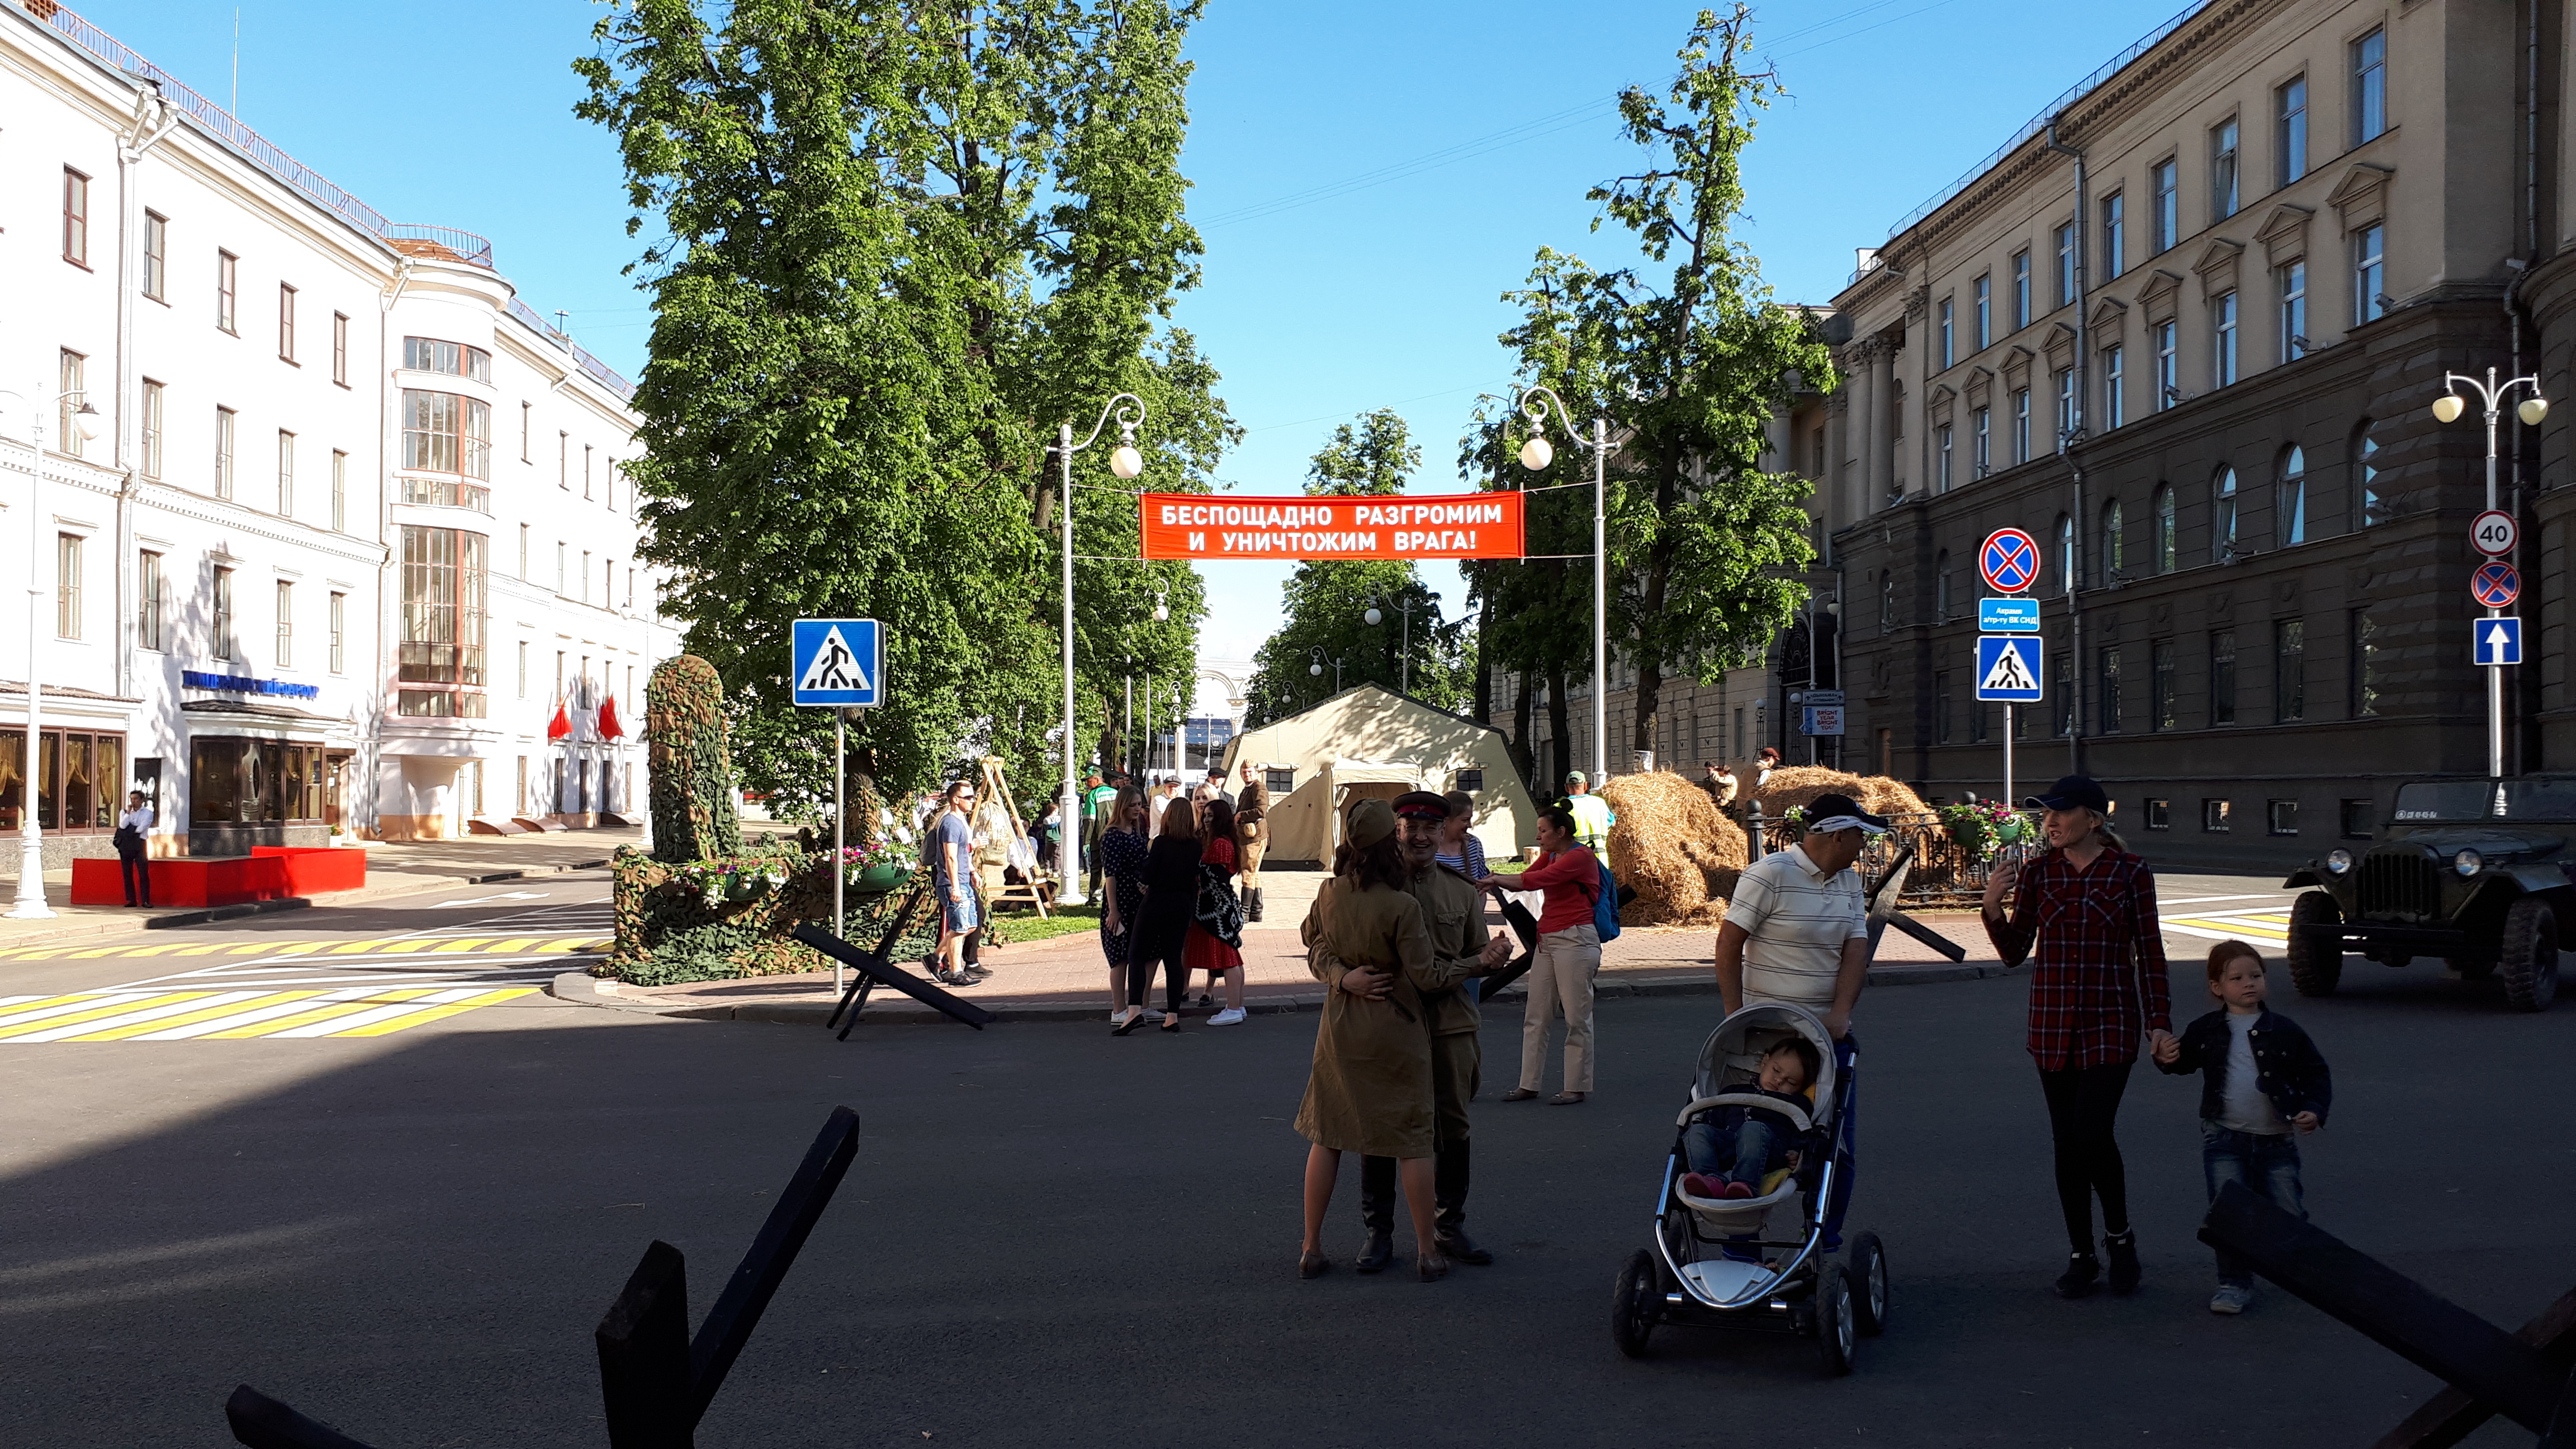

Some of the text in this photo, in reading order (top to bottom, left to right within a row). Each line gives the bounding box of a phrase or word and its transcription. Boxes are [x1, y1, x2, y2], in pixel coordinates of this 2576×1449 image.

[1162, 504, 1502, 529] БЕСПОЩАДНО РАЗГРОМИМ
[1188, 531, 1476, 551] И УНИЧТОЖИМ ВРАГА!
[2479, 525, 2508, 543] 40
[2020, 616, 2037, 624] СНД
